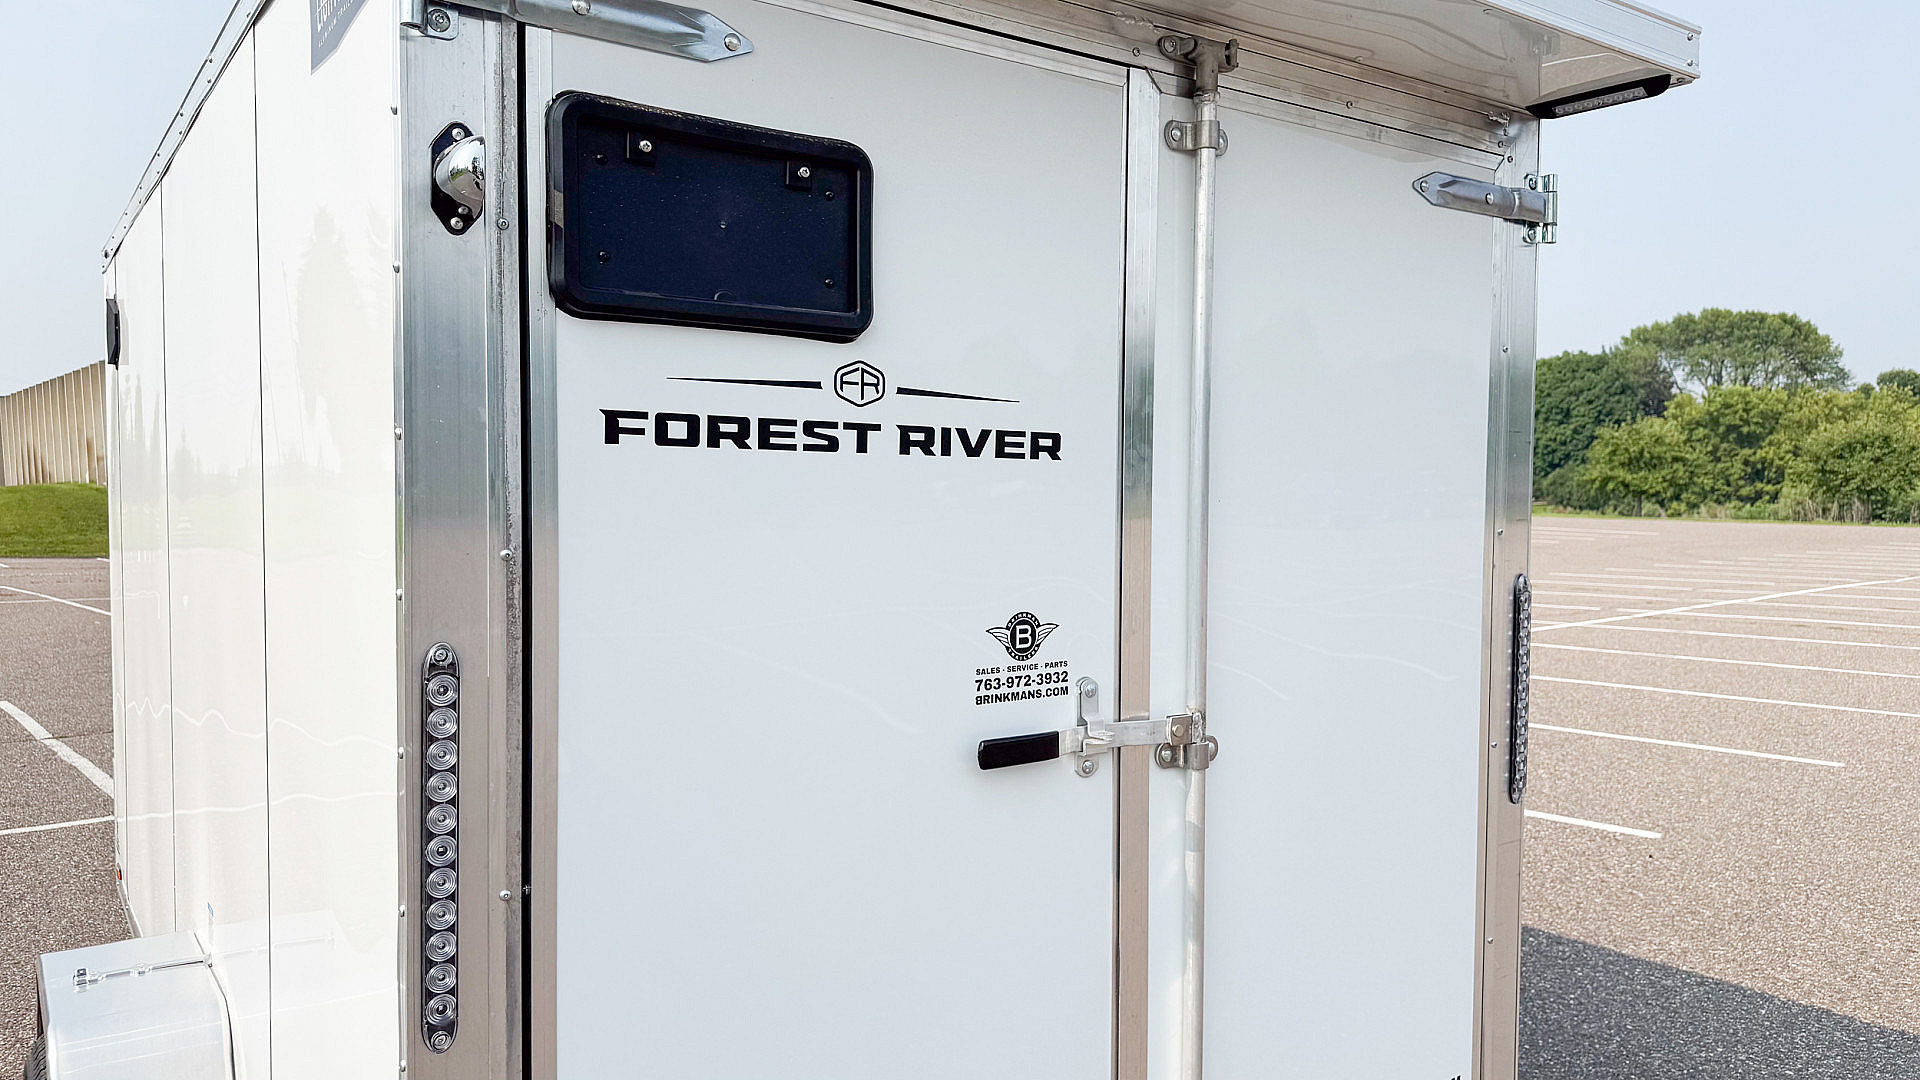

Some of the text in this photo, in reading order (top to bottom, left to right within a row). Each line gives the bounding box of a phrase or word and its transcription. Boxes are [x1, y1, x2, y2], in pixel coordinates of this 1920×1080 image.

[839, 367, 881, 401] FR
[599, 408, 1062, 461] FOREST RIVER
[1015, 624, 1032, 649] B
[975, 660, 1068, 676] SALES SERVICE PARTS
[975, 671, 1069, 692] 763-972-3932
[975, 686, 1069, 705] BRINKMANS.COM
